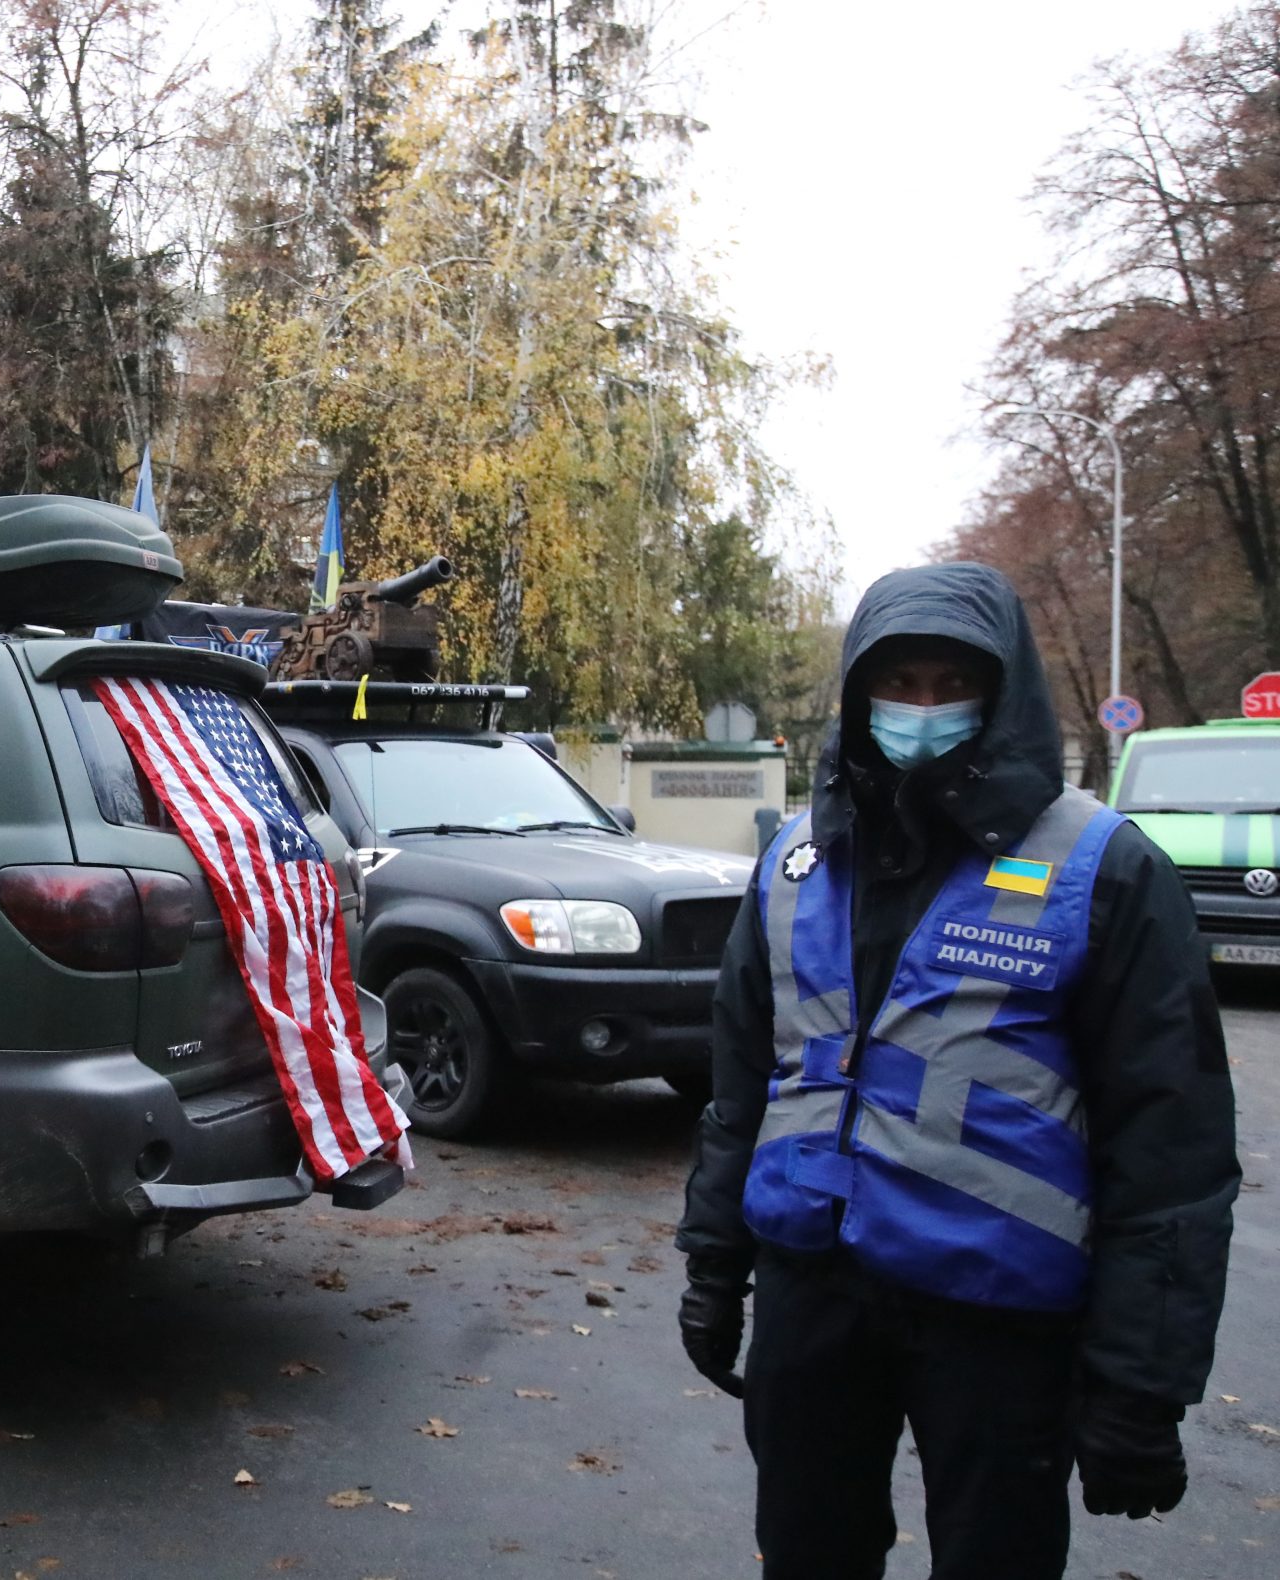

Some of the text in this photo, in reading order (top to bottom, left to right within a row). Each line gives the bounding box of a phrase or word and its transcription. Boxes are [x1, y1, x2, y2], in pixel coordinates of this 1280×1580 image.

[411, 686, 436, 696] 067
[942, 922, 1052, 954] ПОЛІЦІЯ
[937, 944, 1047, 977] ДІАЛОГУ
